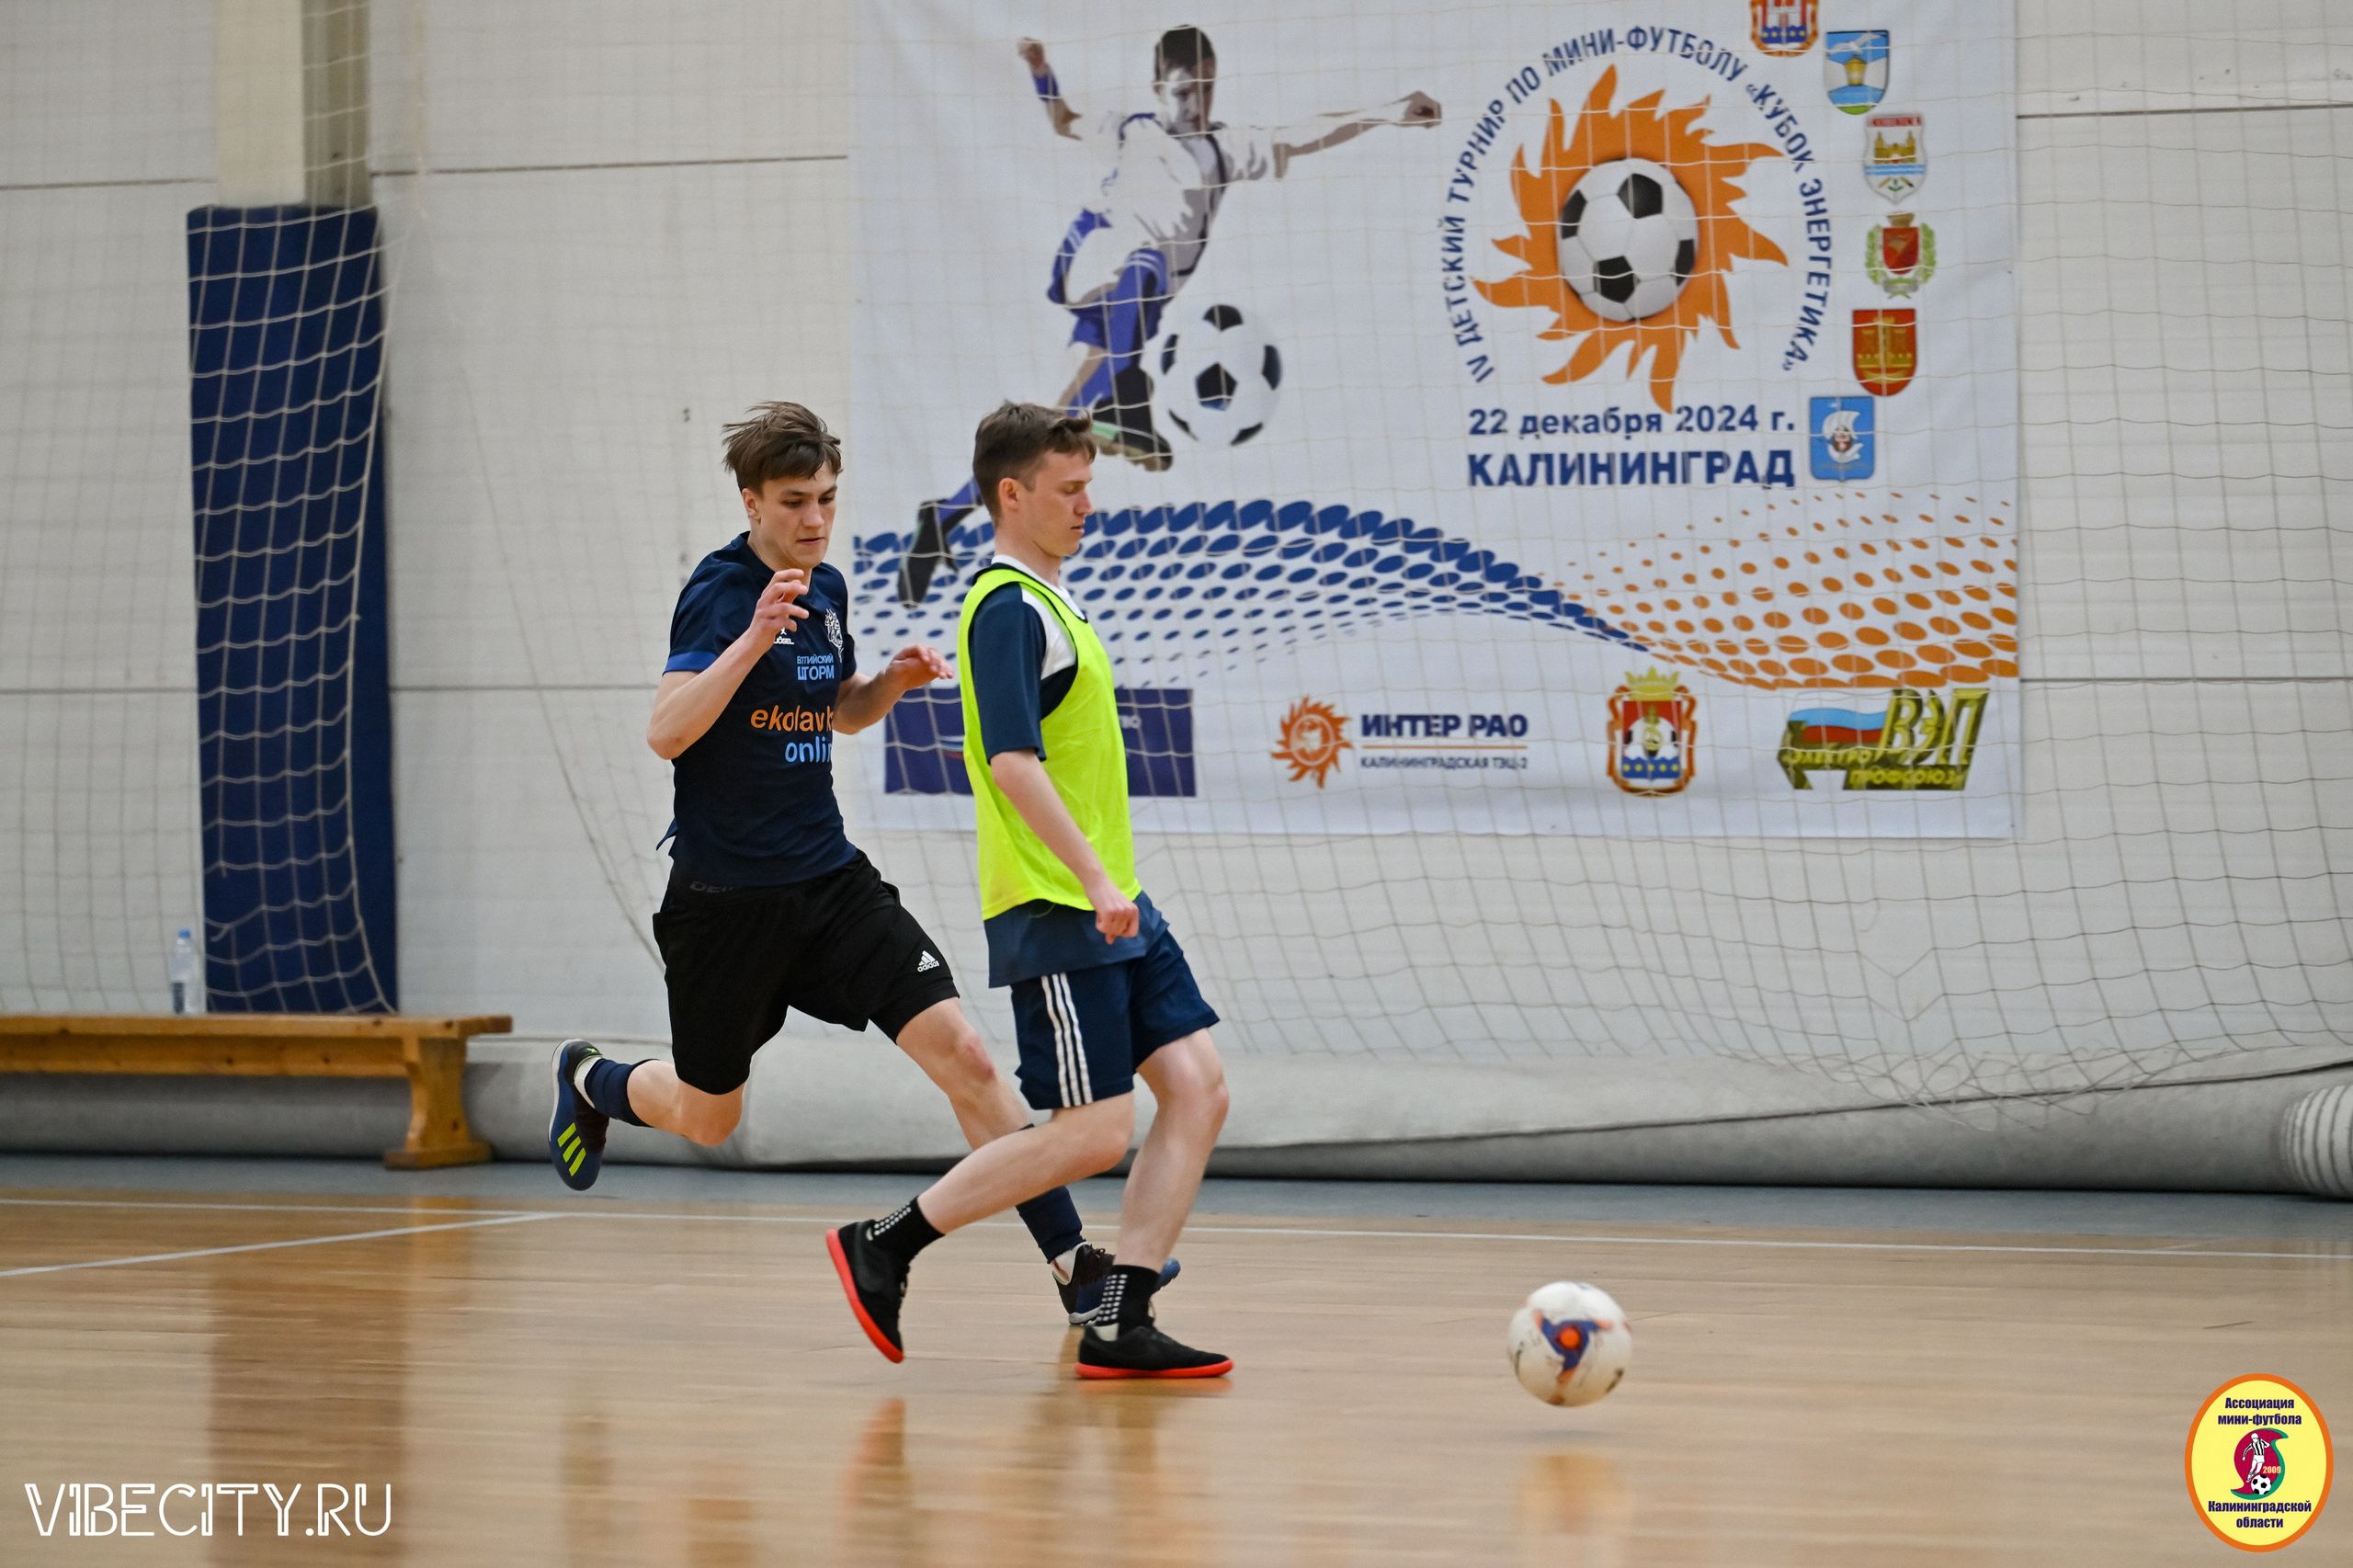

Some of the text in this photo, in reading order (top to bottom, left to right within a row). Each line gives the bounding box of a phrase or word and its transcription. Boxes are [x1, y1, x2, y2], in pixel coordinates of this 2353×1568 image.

[1438, 26, 1832, 383] IV ДЕТСКИЙ ТУРНИР ПО МИНИ-ФУТБОЛУ «КУБОК ЭНЕРГЕТИКА»
[1469, 405, 1795, 440] 22 декабря 2024 г.
[1468, 450, 1795, 489] КАЛИНИНГРАД
[751, 704, 834, 732] ekolavk
[1361, 714, 1529, 737] ИНТЕР РАО
[917, 960, 939, 972] adidas
